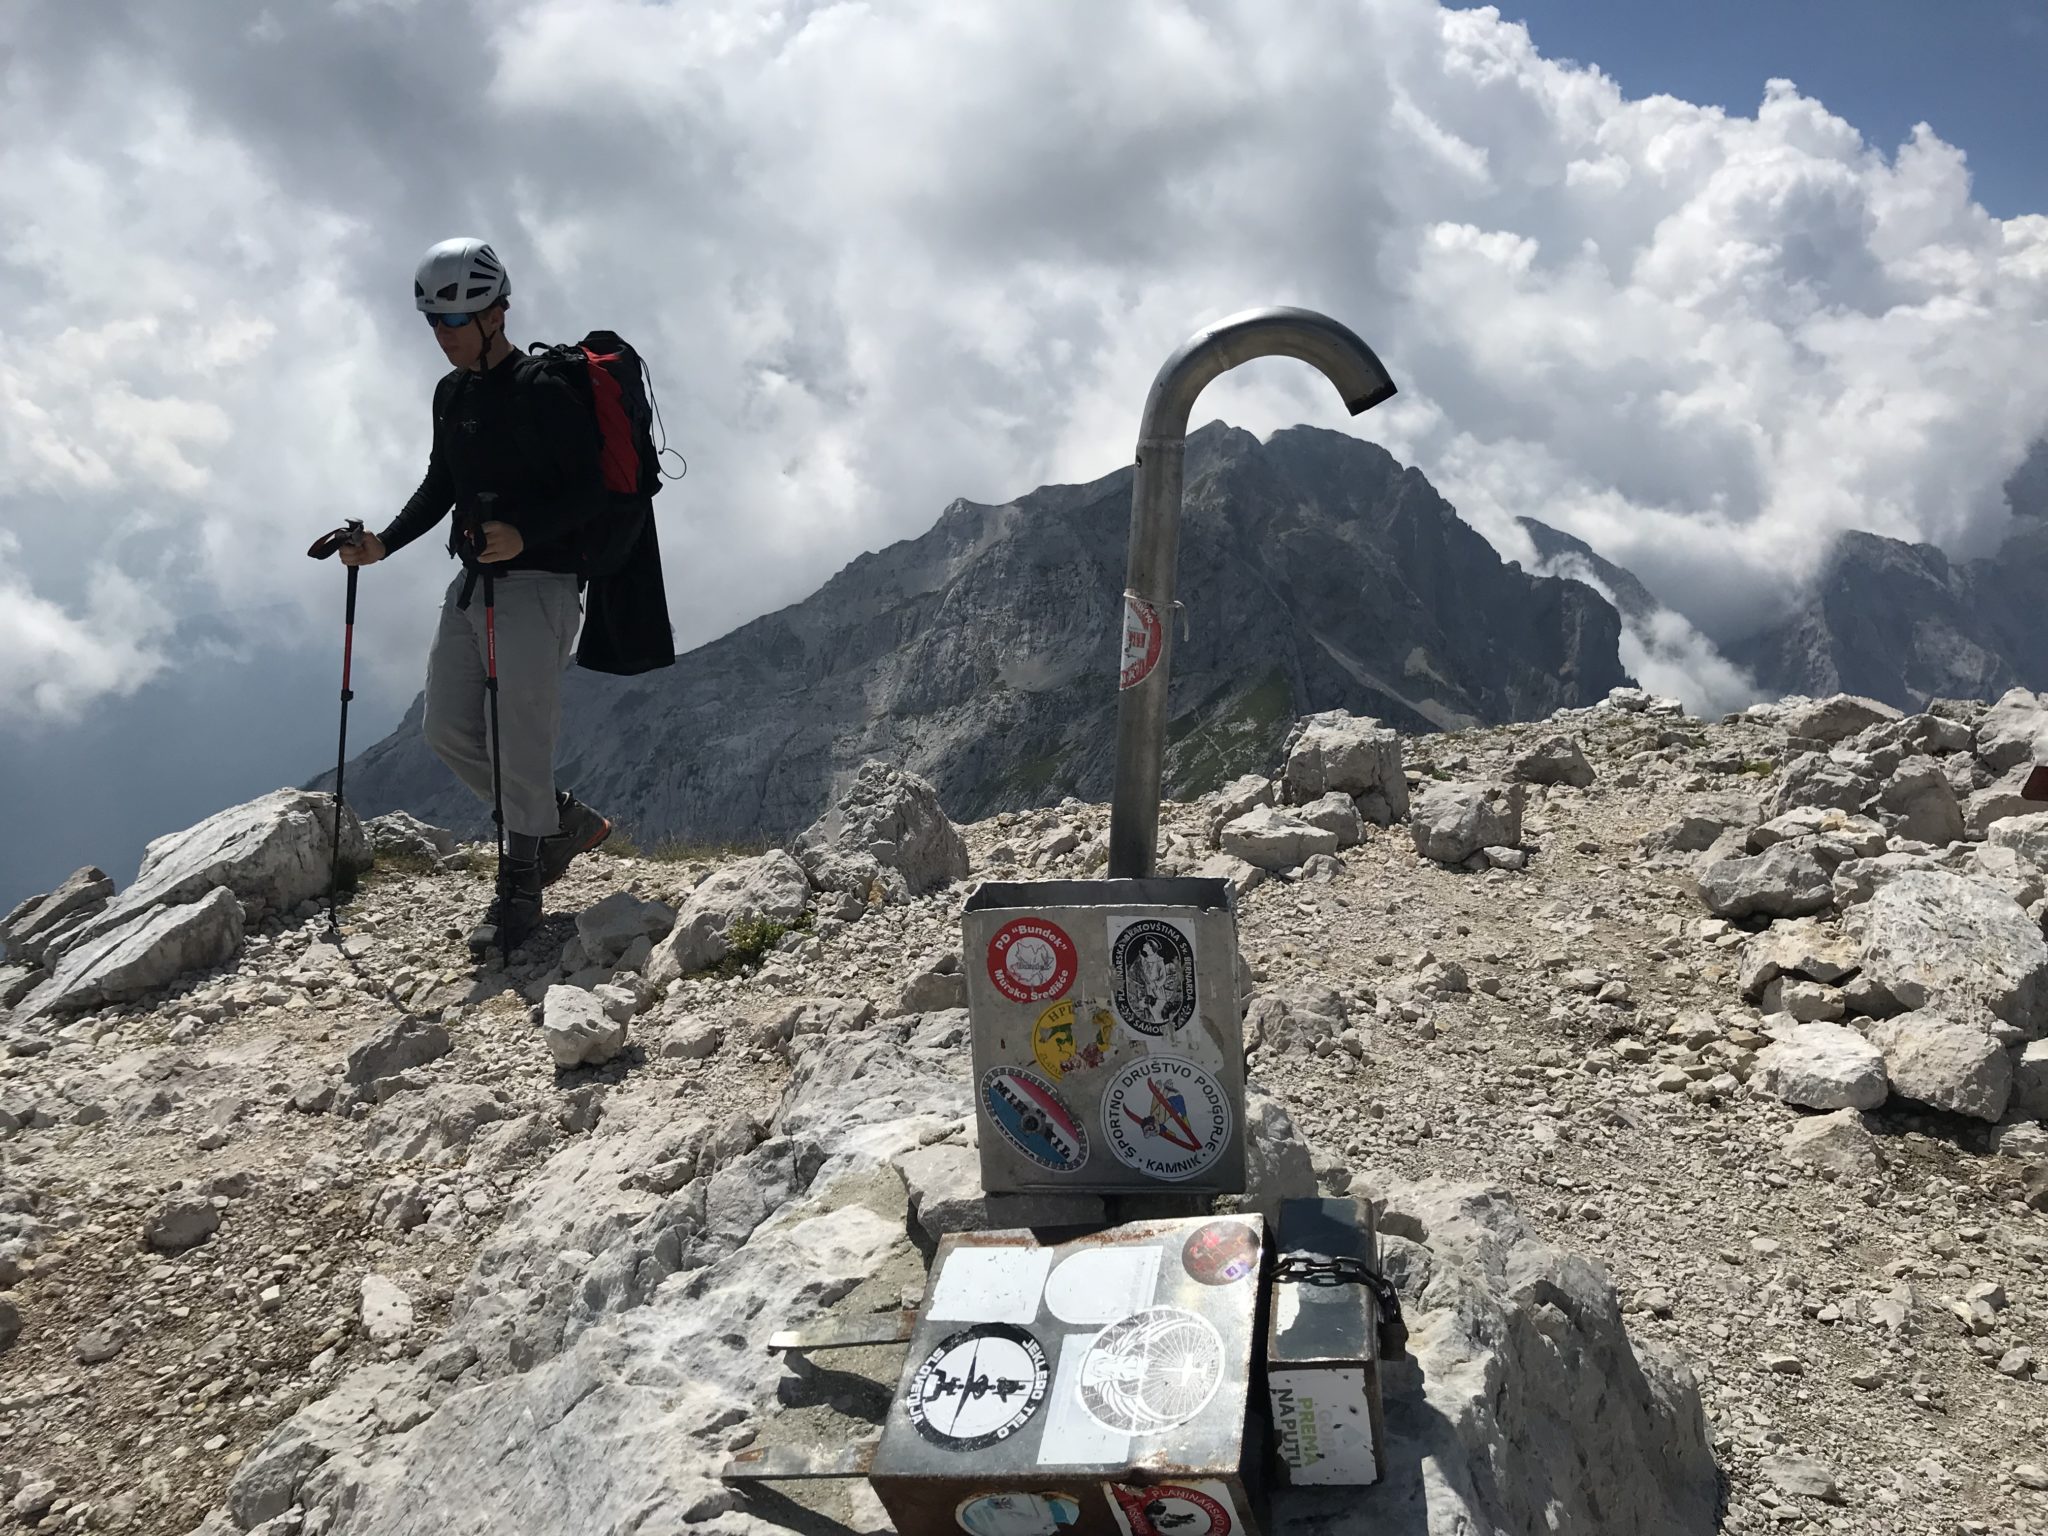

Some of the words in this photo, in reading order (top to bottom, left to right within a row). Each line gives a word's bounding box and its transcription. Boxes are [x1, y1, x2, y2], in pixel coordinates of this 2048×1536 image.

[995, 933, 1011, 950] PD
[1115, 943, 1126, 1001] PLAINARSKA
[1123, 922, 1180, 942] BRATOVŠTINA
[994, 968, 1028, 999] Mursko
[1121, 1060, 1192, 1087] DRUŠTVO
[1109, 1089, 1137, 1159] ŠPORTNO
[1194, 1076, 1225, 1152] PODGORJE
[1145, 1153, 1202, 1173] KAMNIK
[908, 1347, 946, 1425] SLOVENIJA
[996, 1405, 1037, 1439] TELO
[1297, 1397, 1320, 1467] PREMA
[1151, 1488, 1225, 1527] PLANINARSKO
